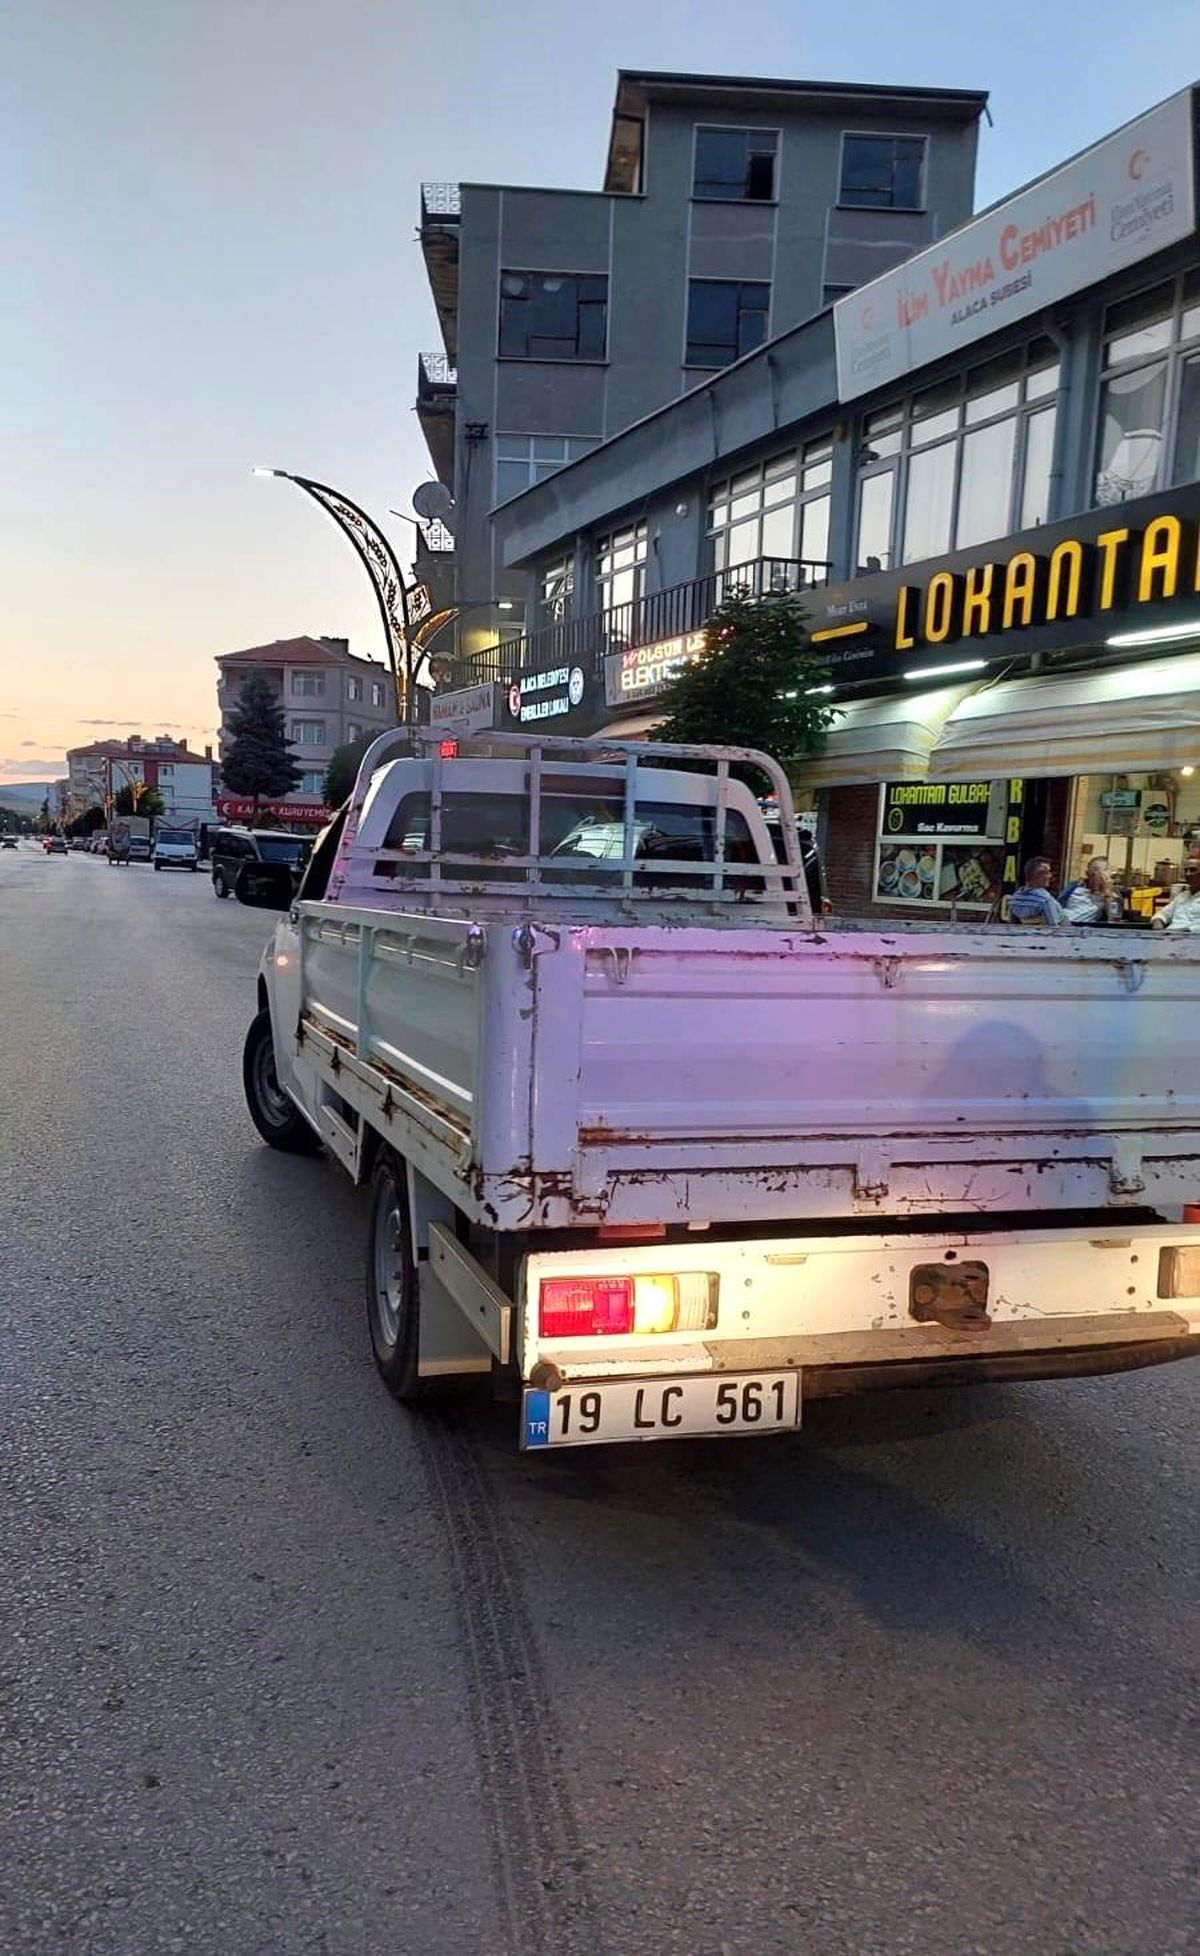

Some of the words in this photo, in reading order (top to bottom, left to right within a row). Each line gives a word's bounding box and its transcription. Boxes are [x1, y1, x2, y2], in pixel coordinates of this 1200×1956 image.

[932, 259, 995, 309] YAYMA
[999, 192, 1097, 272] CEMİYETİ
[950, 297, 990, 327] ALACA
[895, 514, 1200, 650] LOKANTA
[889, 785, 946, 805] LOKANTAM
[936, 822, 980, 833] Kavurma
[556, 1391, 602, 1435] 19
[634, 1386, 684, 1429] LC
[715, 1380, 785, 1425] 561
[528, 1421, 548, 1435] TR
